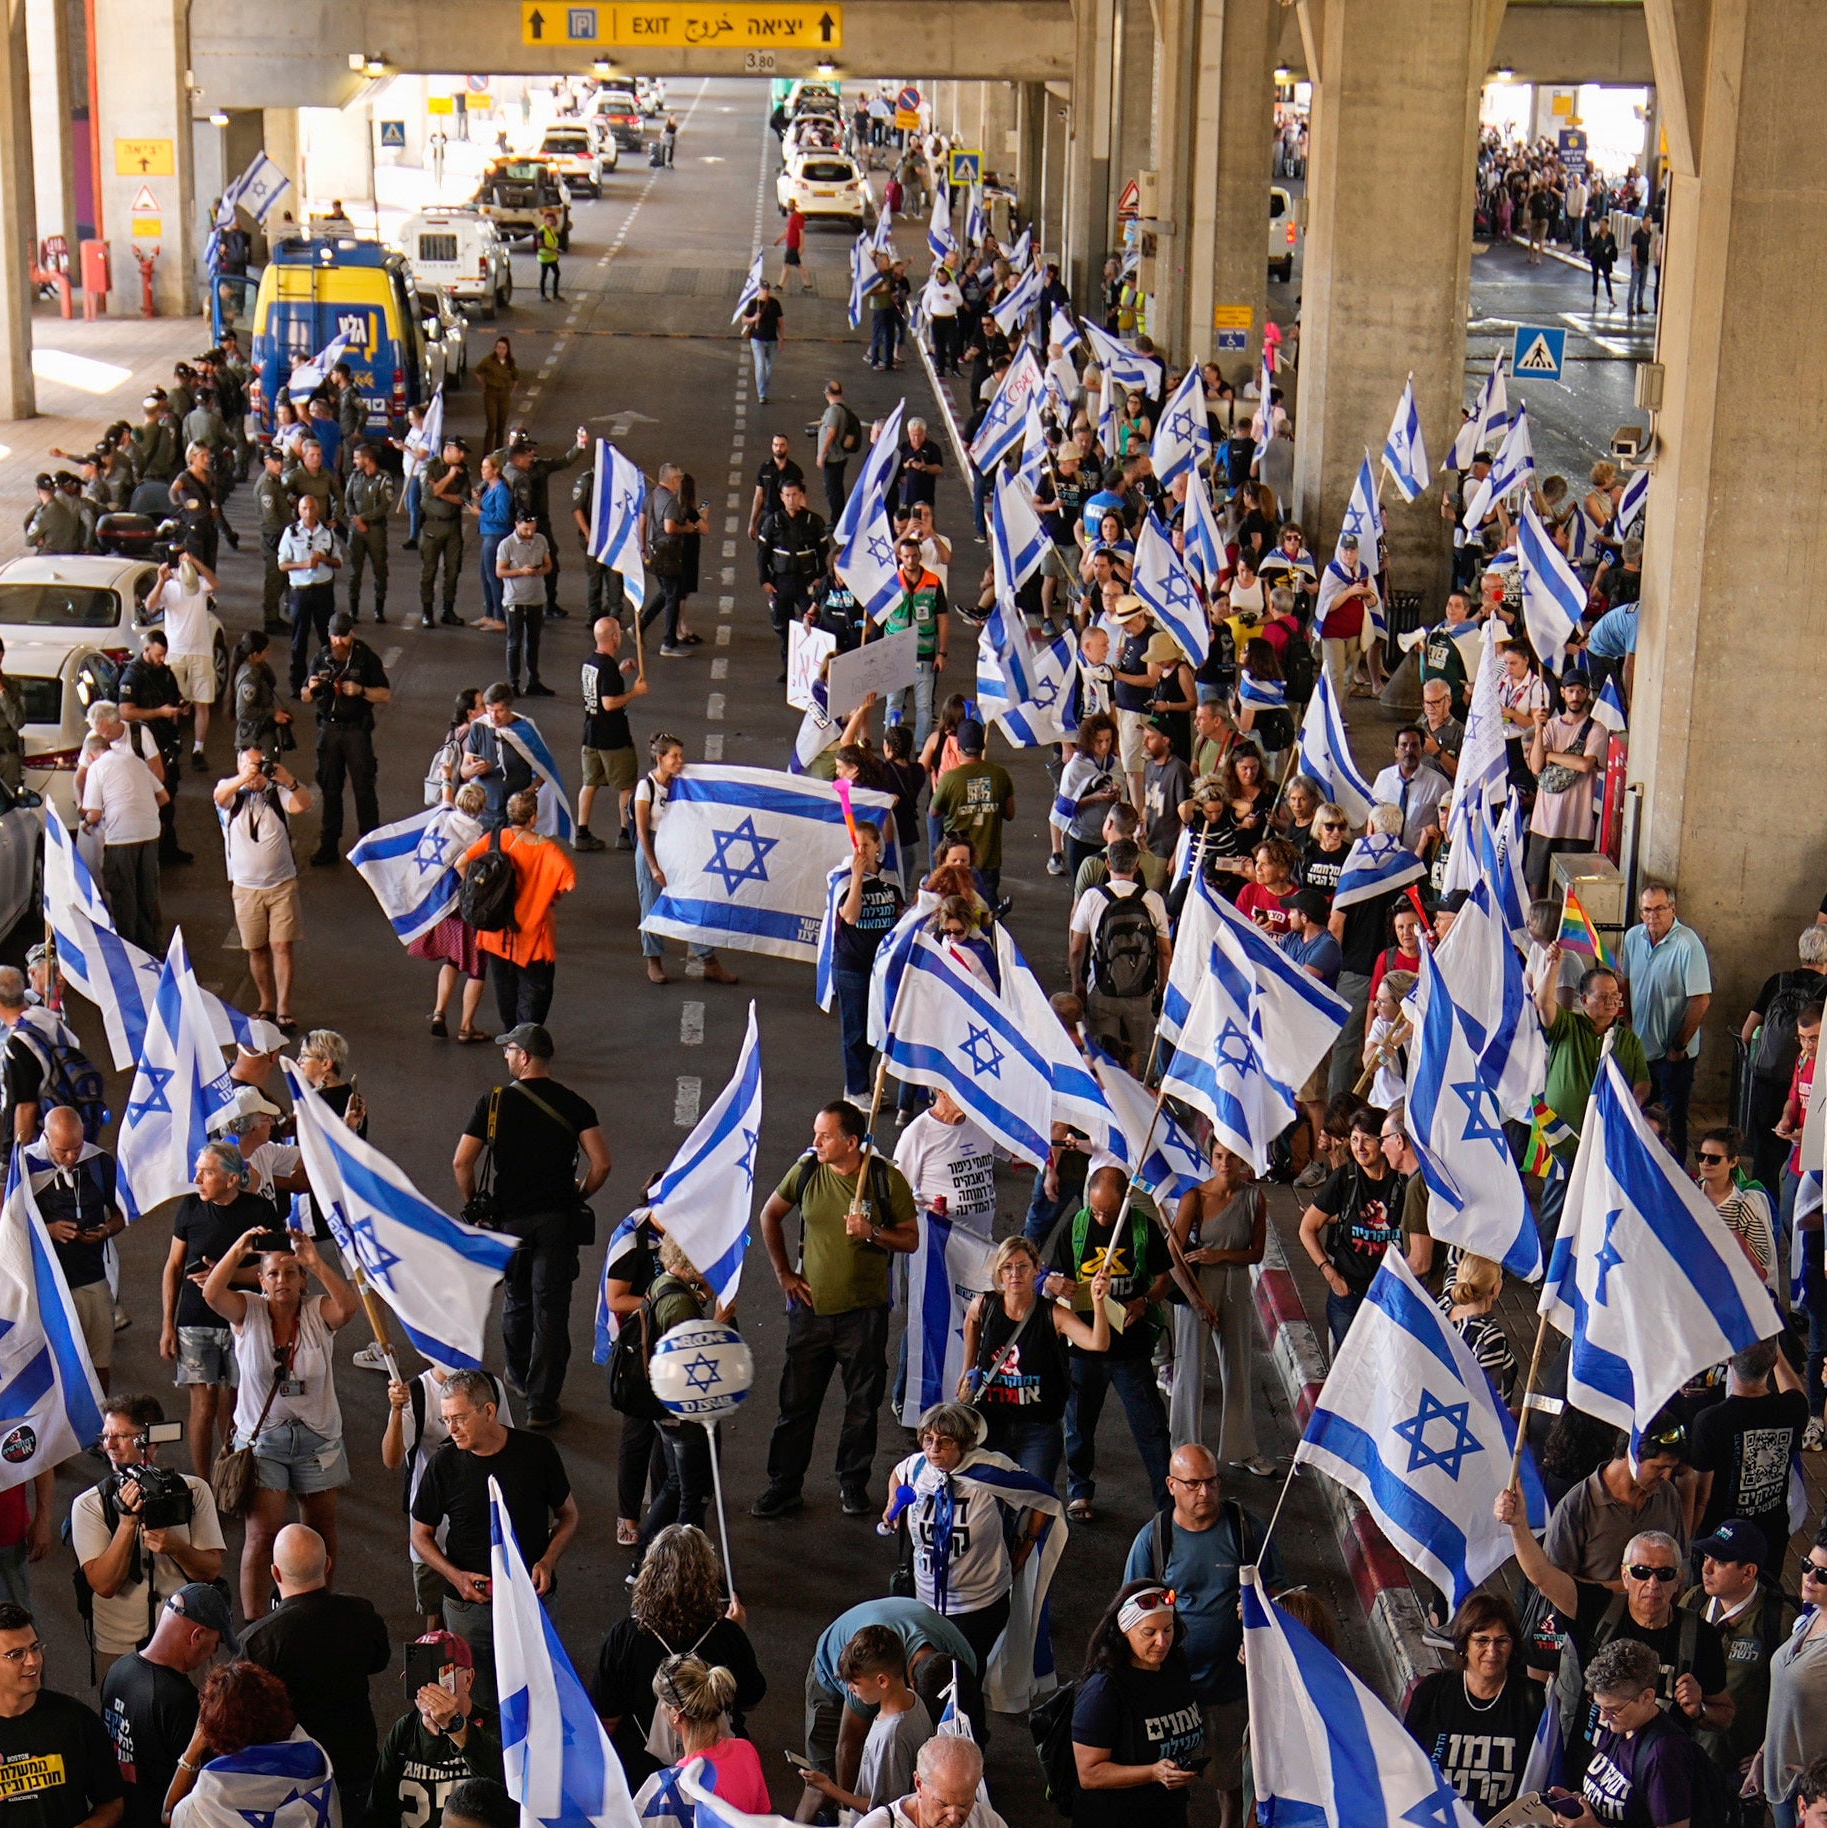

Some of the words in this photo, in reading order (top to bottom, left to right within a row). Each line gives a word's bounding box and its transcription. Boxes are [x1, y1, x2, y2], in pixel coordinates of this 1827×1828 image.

[633, 17, 670, 35] EXIT
[686, 15, 735, 43] خروج
[748, 18, 805, 37] יציאה
[747, 53, 775, 69] 3.80
[1307, 872, 1329, 886] הבית
[1309, 863, 1342, 877] מלחמה
[947, 1158, 971, 1177] כיפור
[1446, 1733, 1516, 1770] דמו
[0, 1760, 50, 1781] ממשלת
[26, 1770, 62, 1788] חורבן
